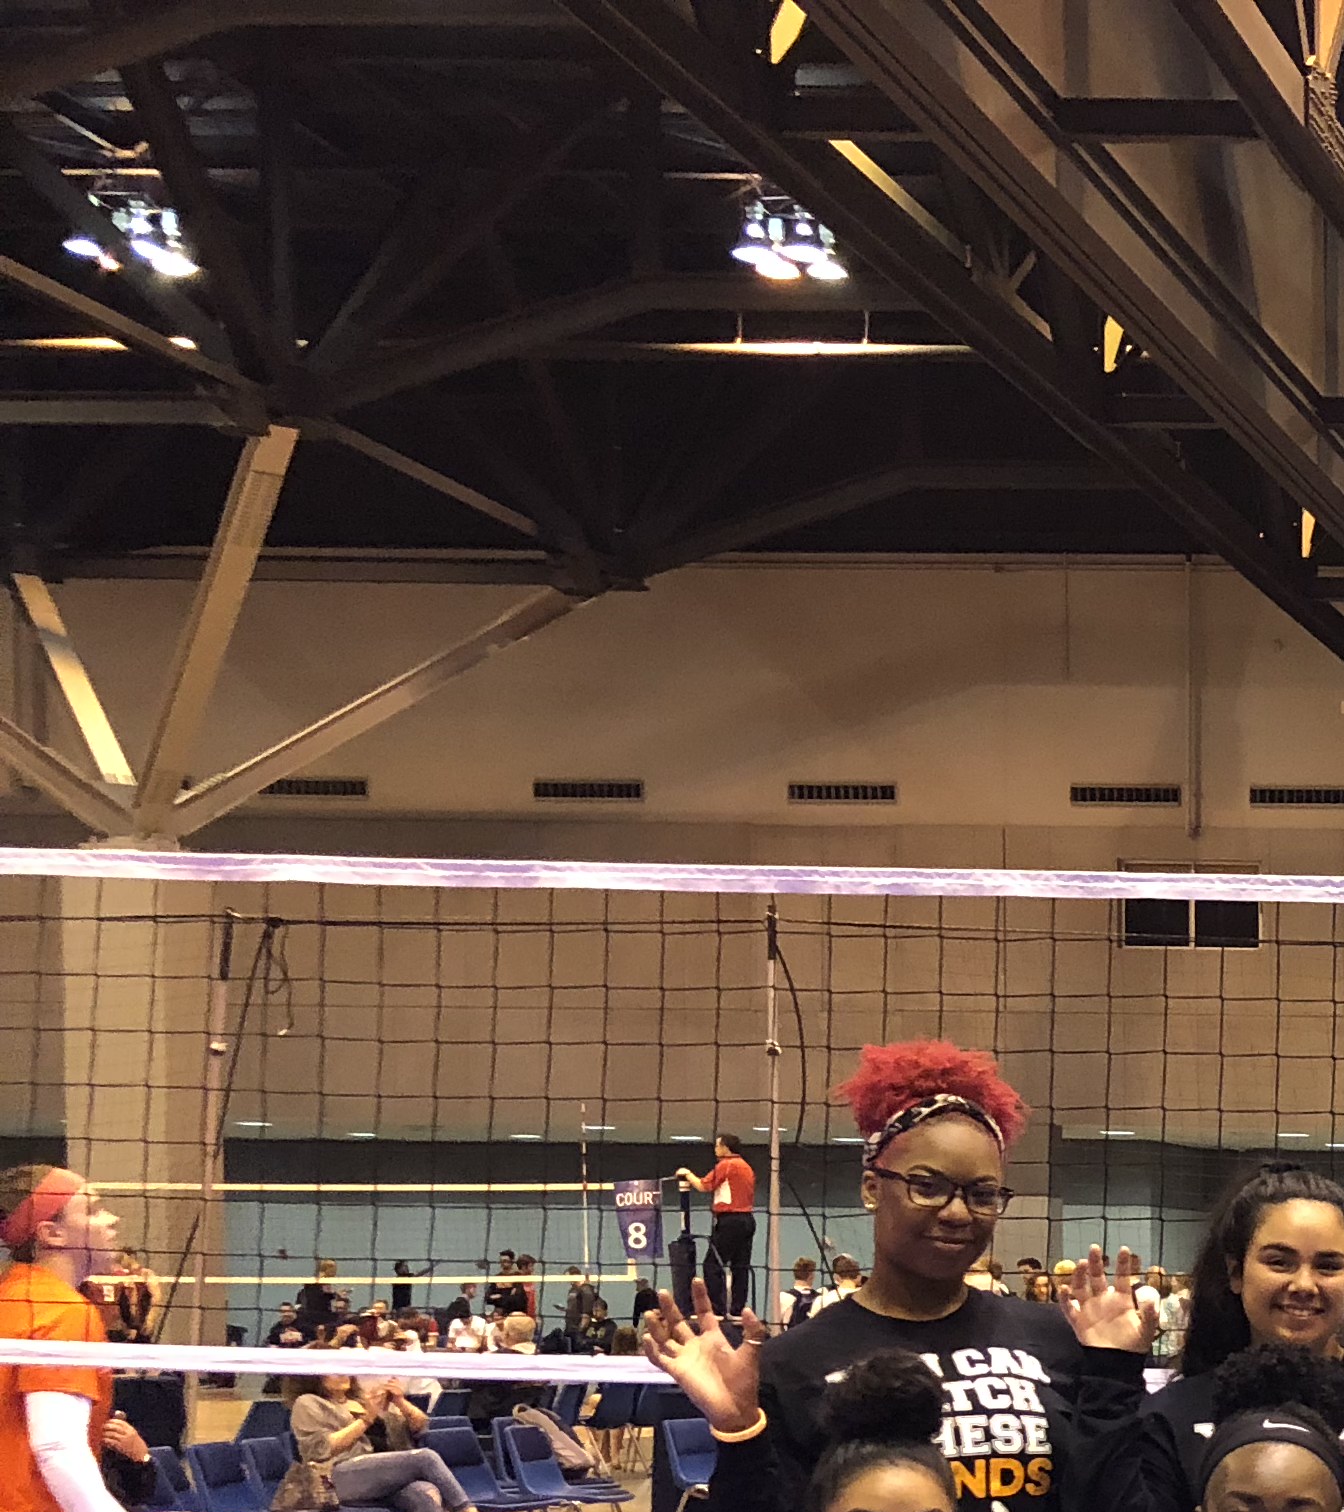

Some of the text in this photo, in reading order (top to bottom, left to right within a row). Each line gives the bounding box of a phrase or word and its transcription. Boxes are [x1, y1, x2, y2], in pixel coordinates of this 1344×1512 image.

[627, 1222, 647, 1249] 8
[941, 1376, 1045, 1413] TCH
[931, 1414, 1052, 1459] HESE
[950, 1457, 1054, 1499] NDS
